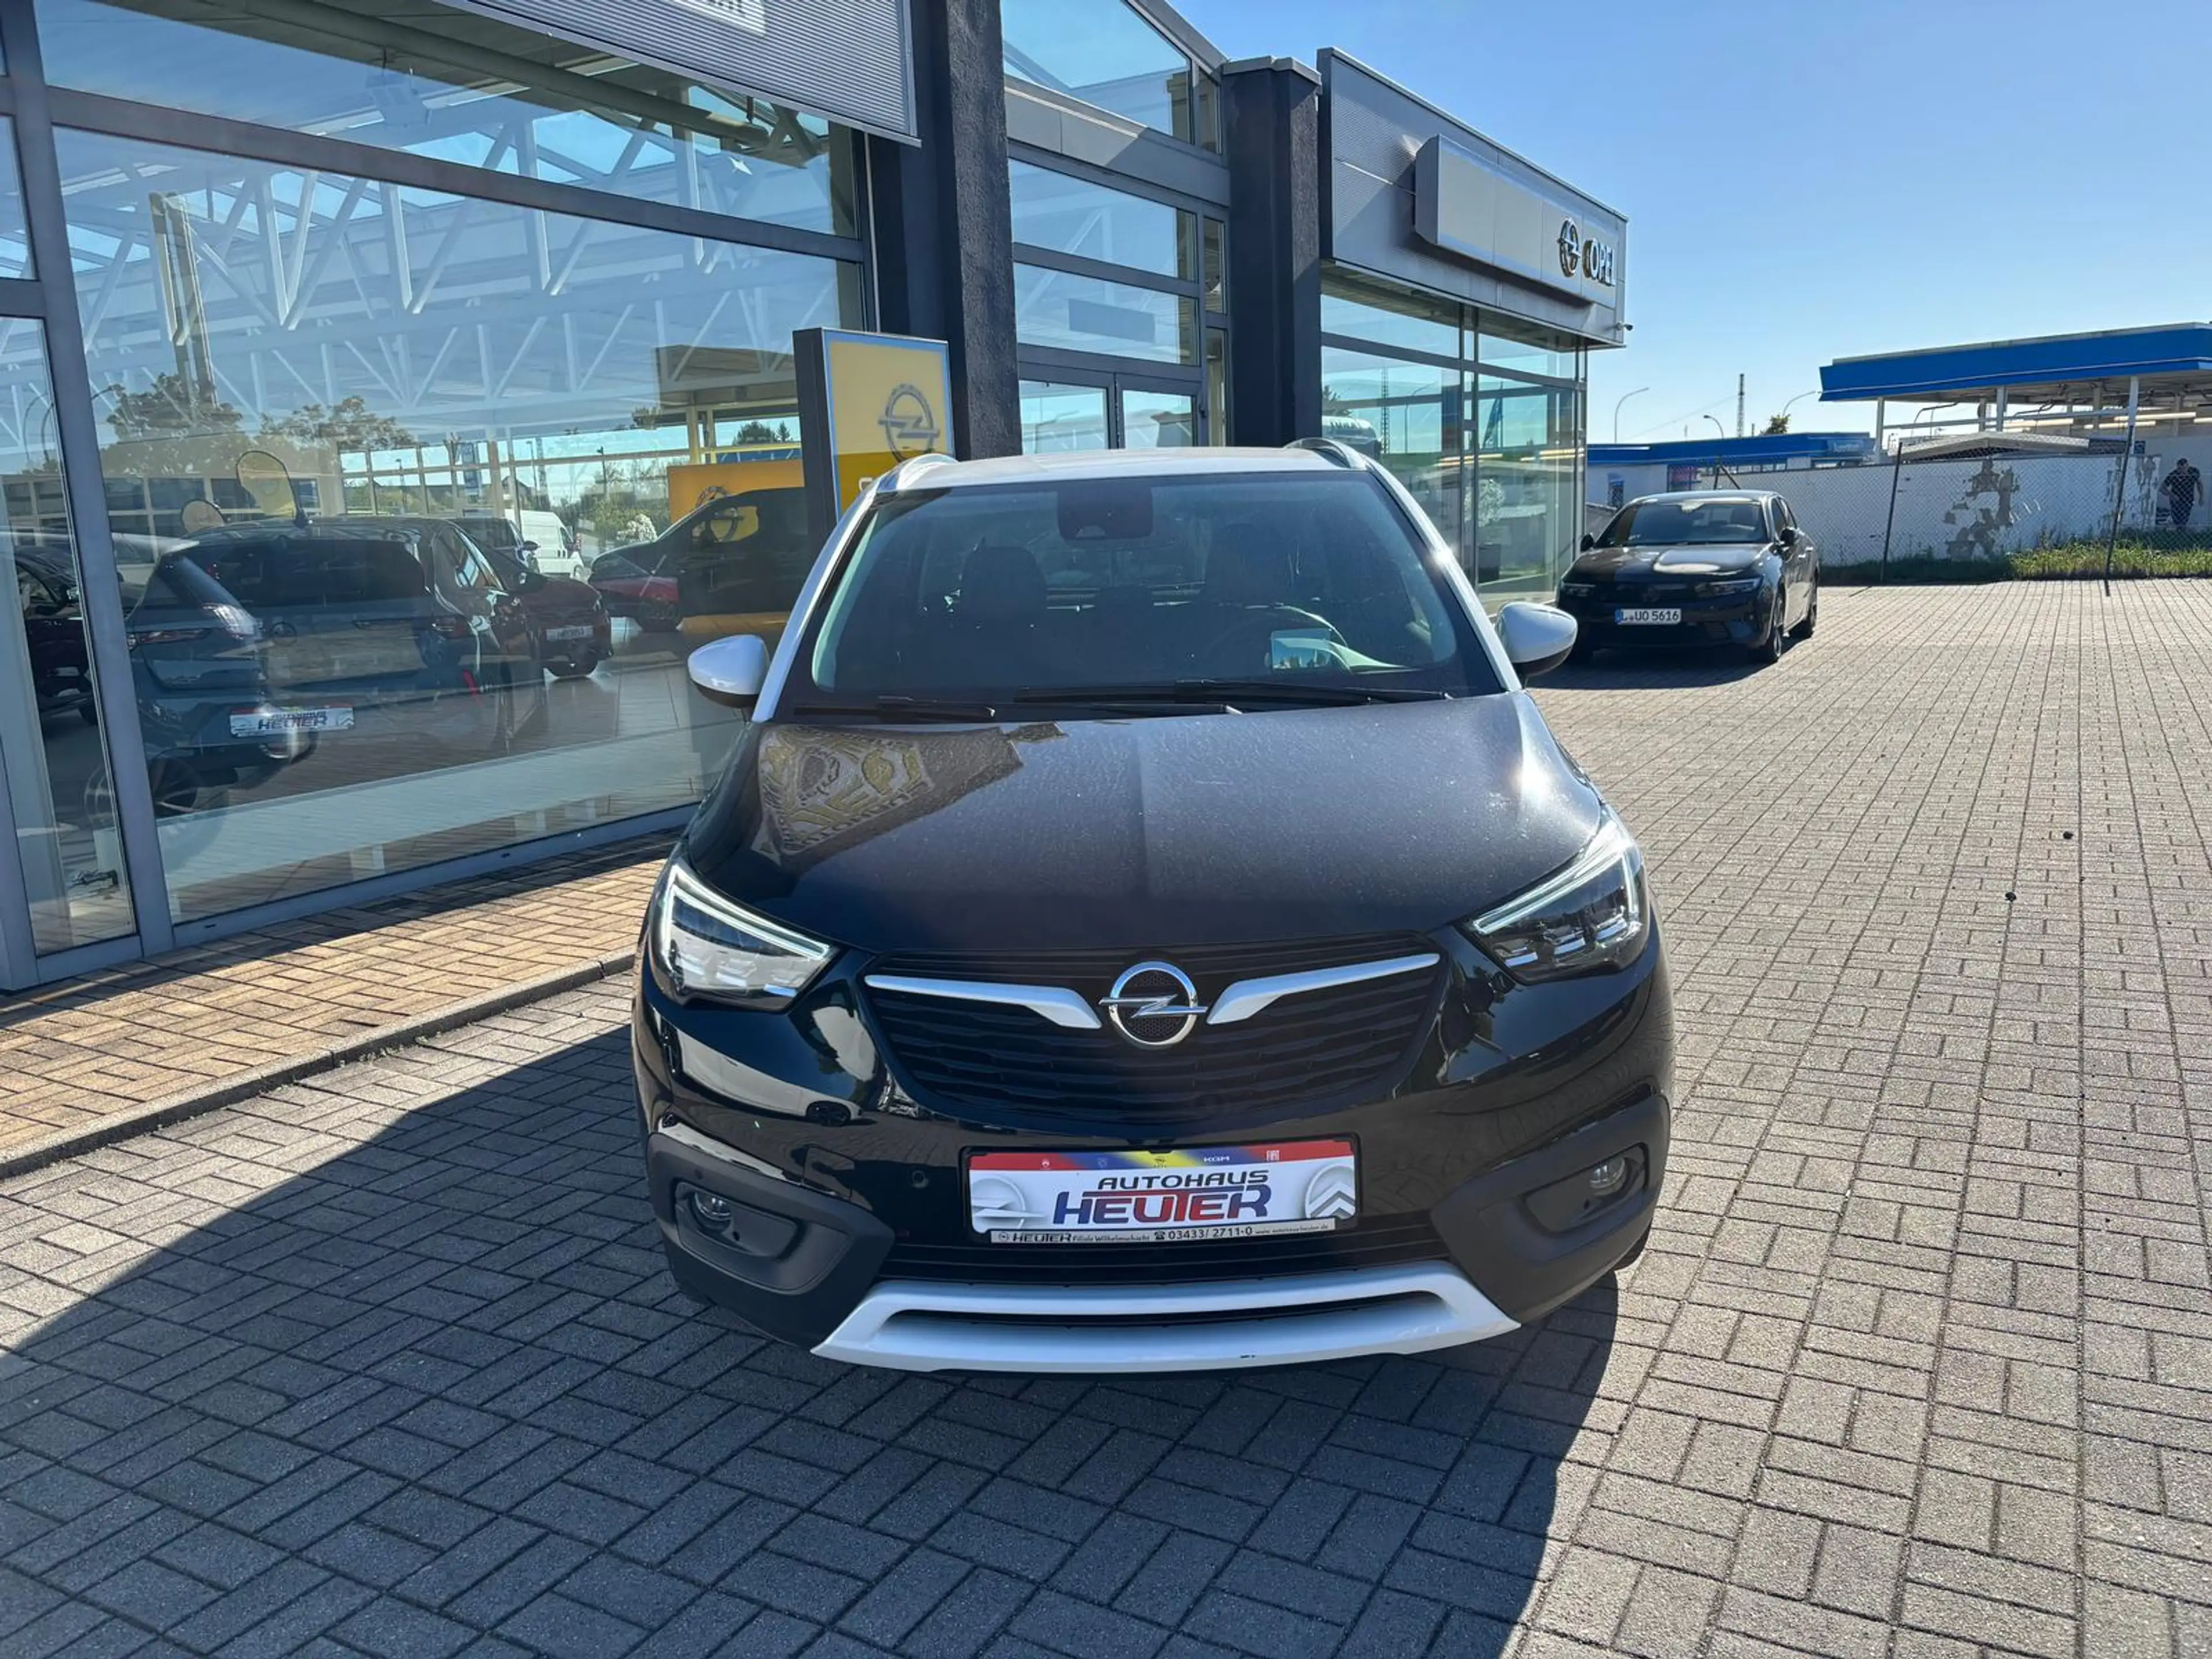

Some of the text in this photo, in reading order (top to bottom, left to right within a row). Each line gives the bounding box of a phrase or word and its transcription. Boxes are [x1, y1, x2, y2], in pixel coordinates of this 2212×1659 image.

[1635, 611, 1649, 622] UO
[1652, 611, 1679, 622] 5616
[1097, 1169, 1269, 1190] AUTOHAUS
[1052, 1184, 1272, 1225] HEUTER
[1012, 1233, 1072, 1243] HEUTER
[1168, 1229, 1209, 1240] 03433/
[1212, 1226, 1253, 1237] 2711-0
